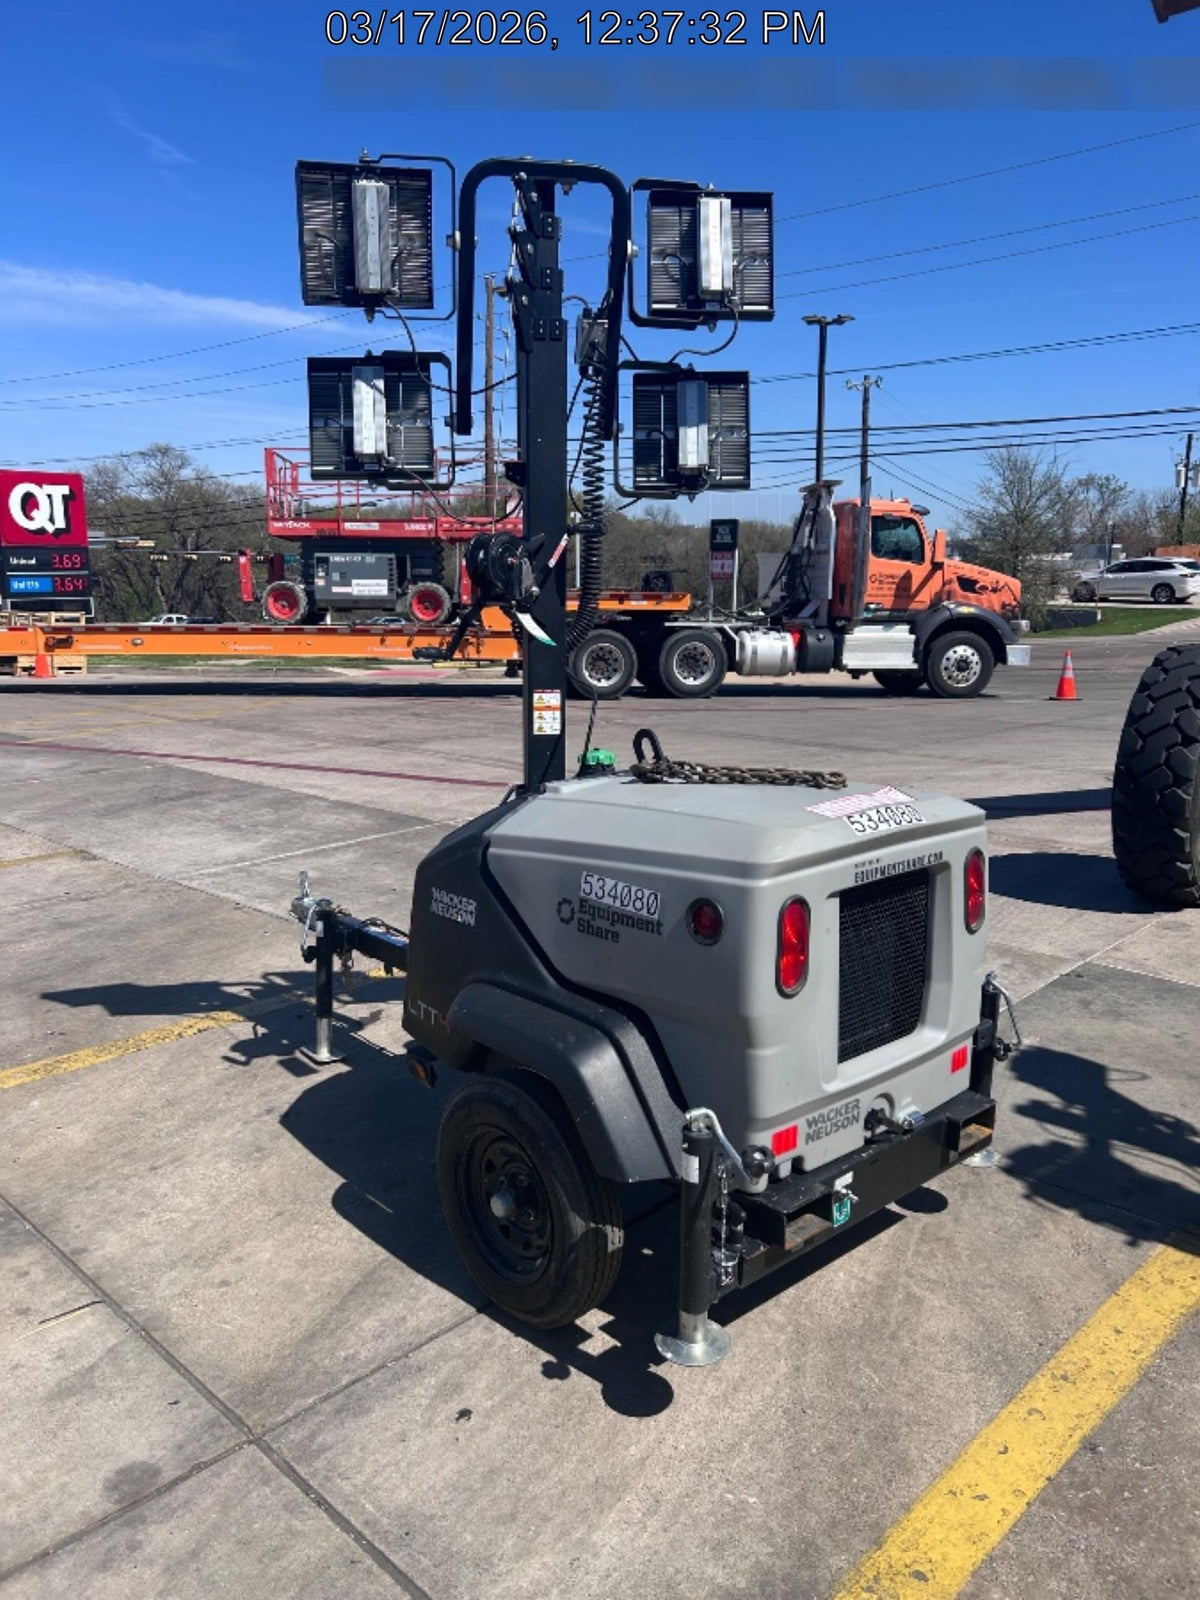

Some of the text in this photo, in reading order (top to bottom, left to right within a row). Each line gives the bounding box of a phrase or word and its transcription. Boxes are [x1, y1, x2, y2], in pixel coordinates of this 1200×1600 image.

[8, 482, 71, 534] QT
[52, 554, 81, 568] 3.69
[54, 577, 83, 591] 3.64
[847, 804, 923, 833] 534080
[431, 886, 477, 911] WACKER
[582, 874, 659, 916] 534080
[430, 900, 476, 927] NEUSON
[578, 897, 664, 936] Equipment
[577, 917, 620, 944] Share
[804, 1111, 860, 1146] NEUSON
[805, 1098, 861, 1131] WACKER
